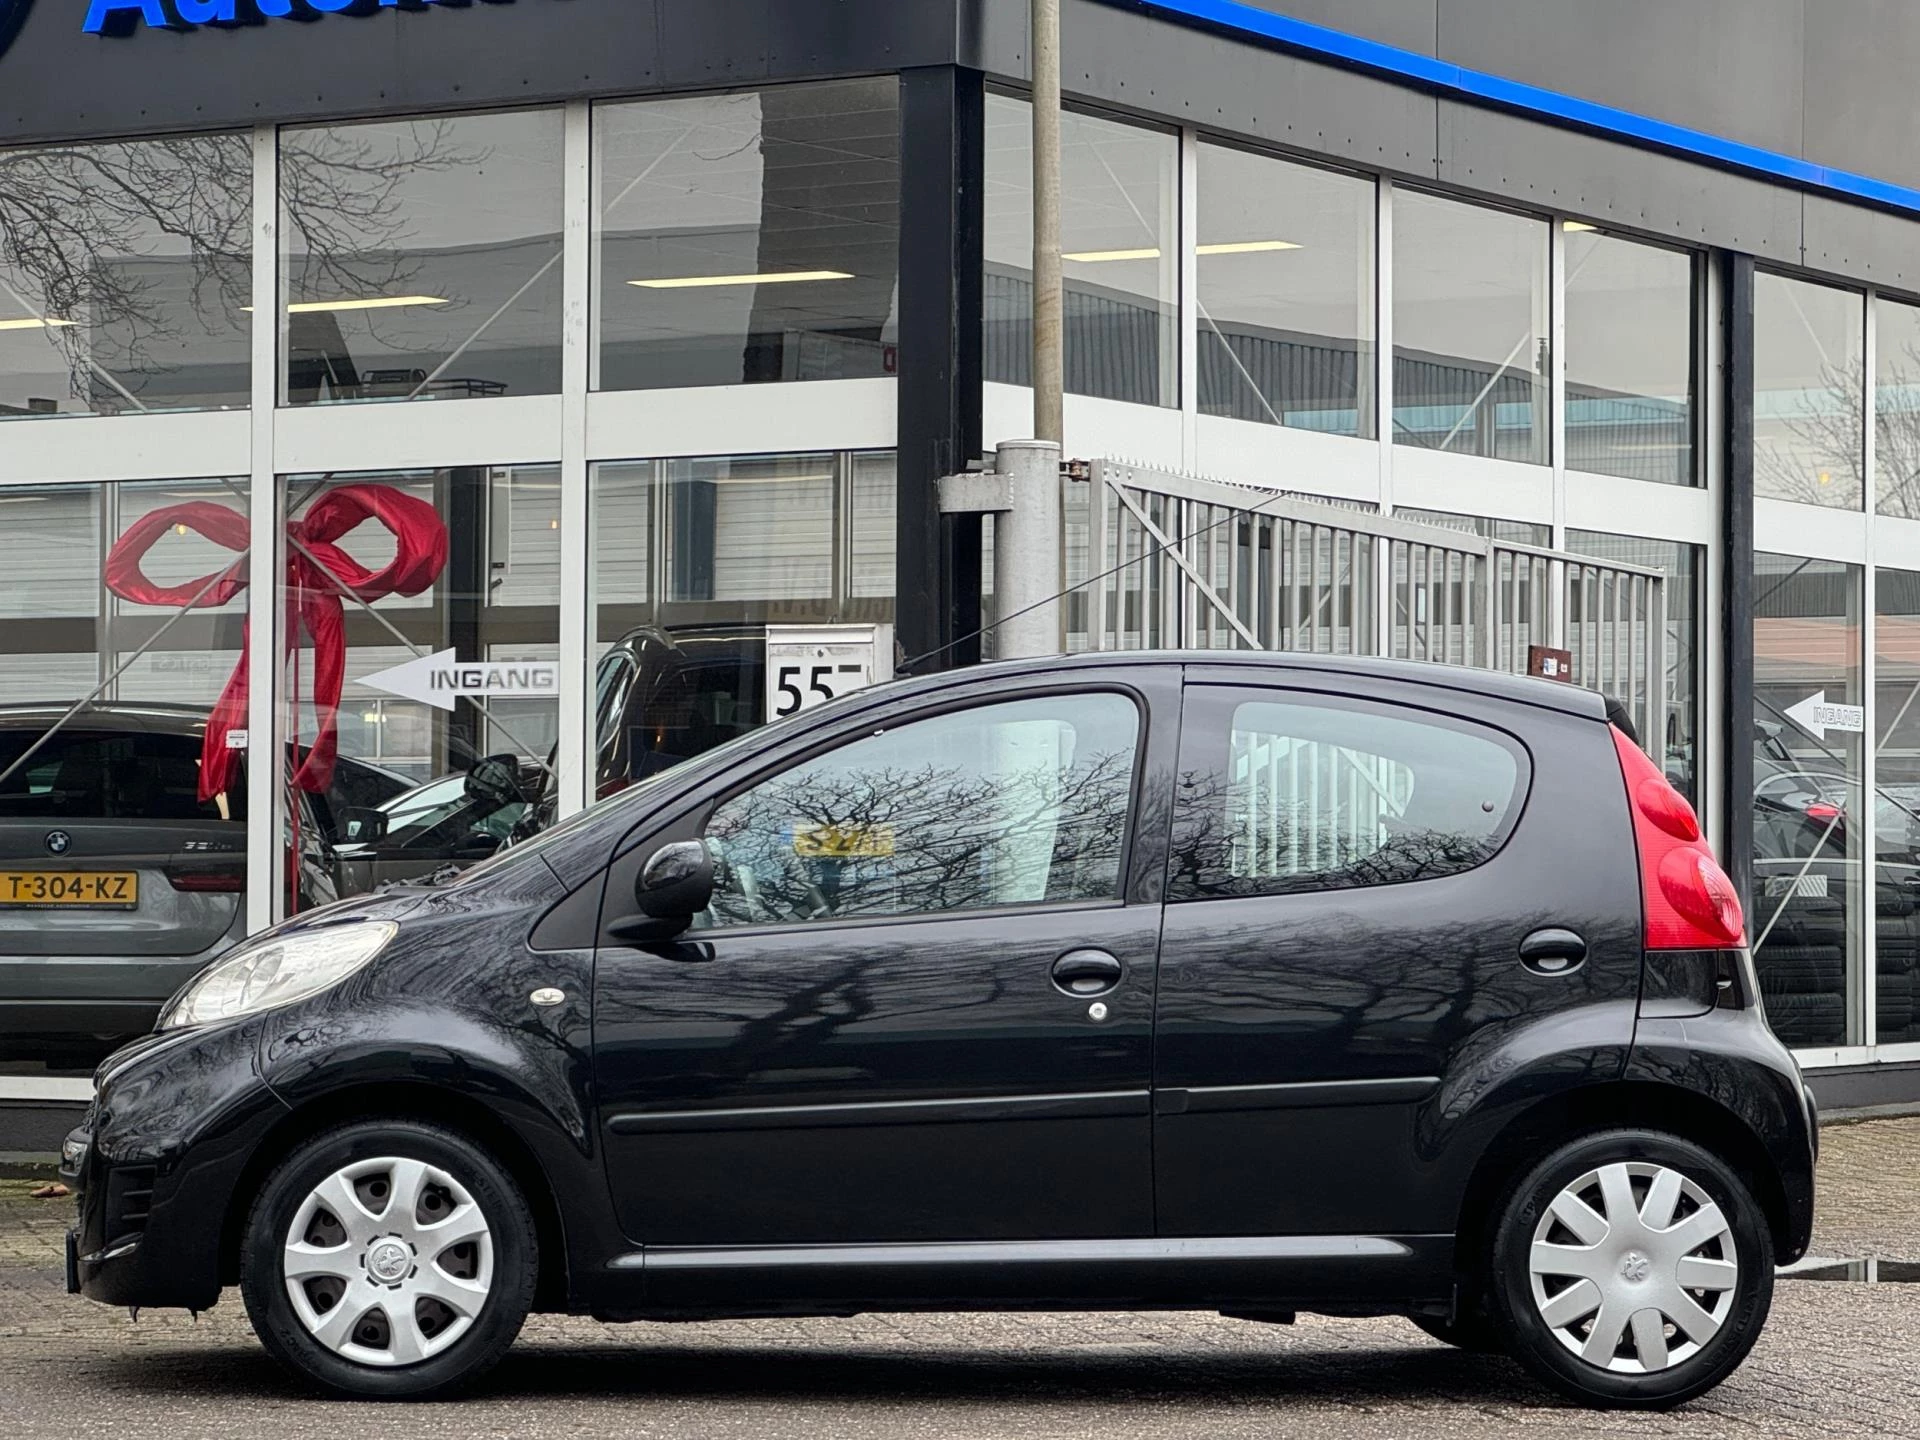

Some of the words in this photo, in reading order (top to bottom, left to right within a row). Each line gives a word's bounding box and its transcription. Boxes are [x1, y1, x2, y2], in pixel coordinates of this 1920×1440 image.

[430, 668, 554, 690] INGANG
[1813, 706, 1862, 728] INGANG
[8, 876, 128, 899] T-304-KZ
